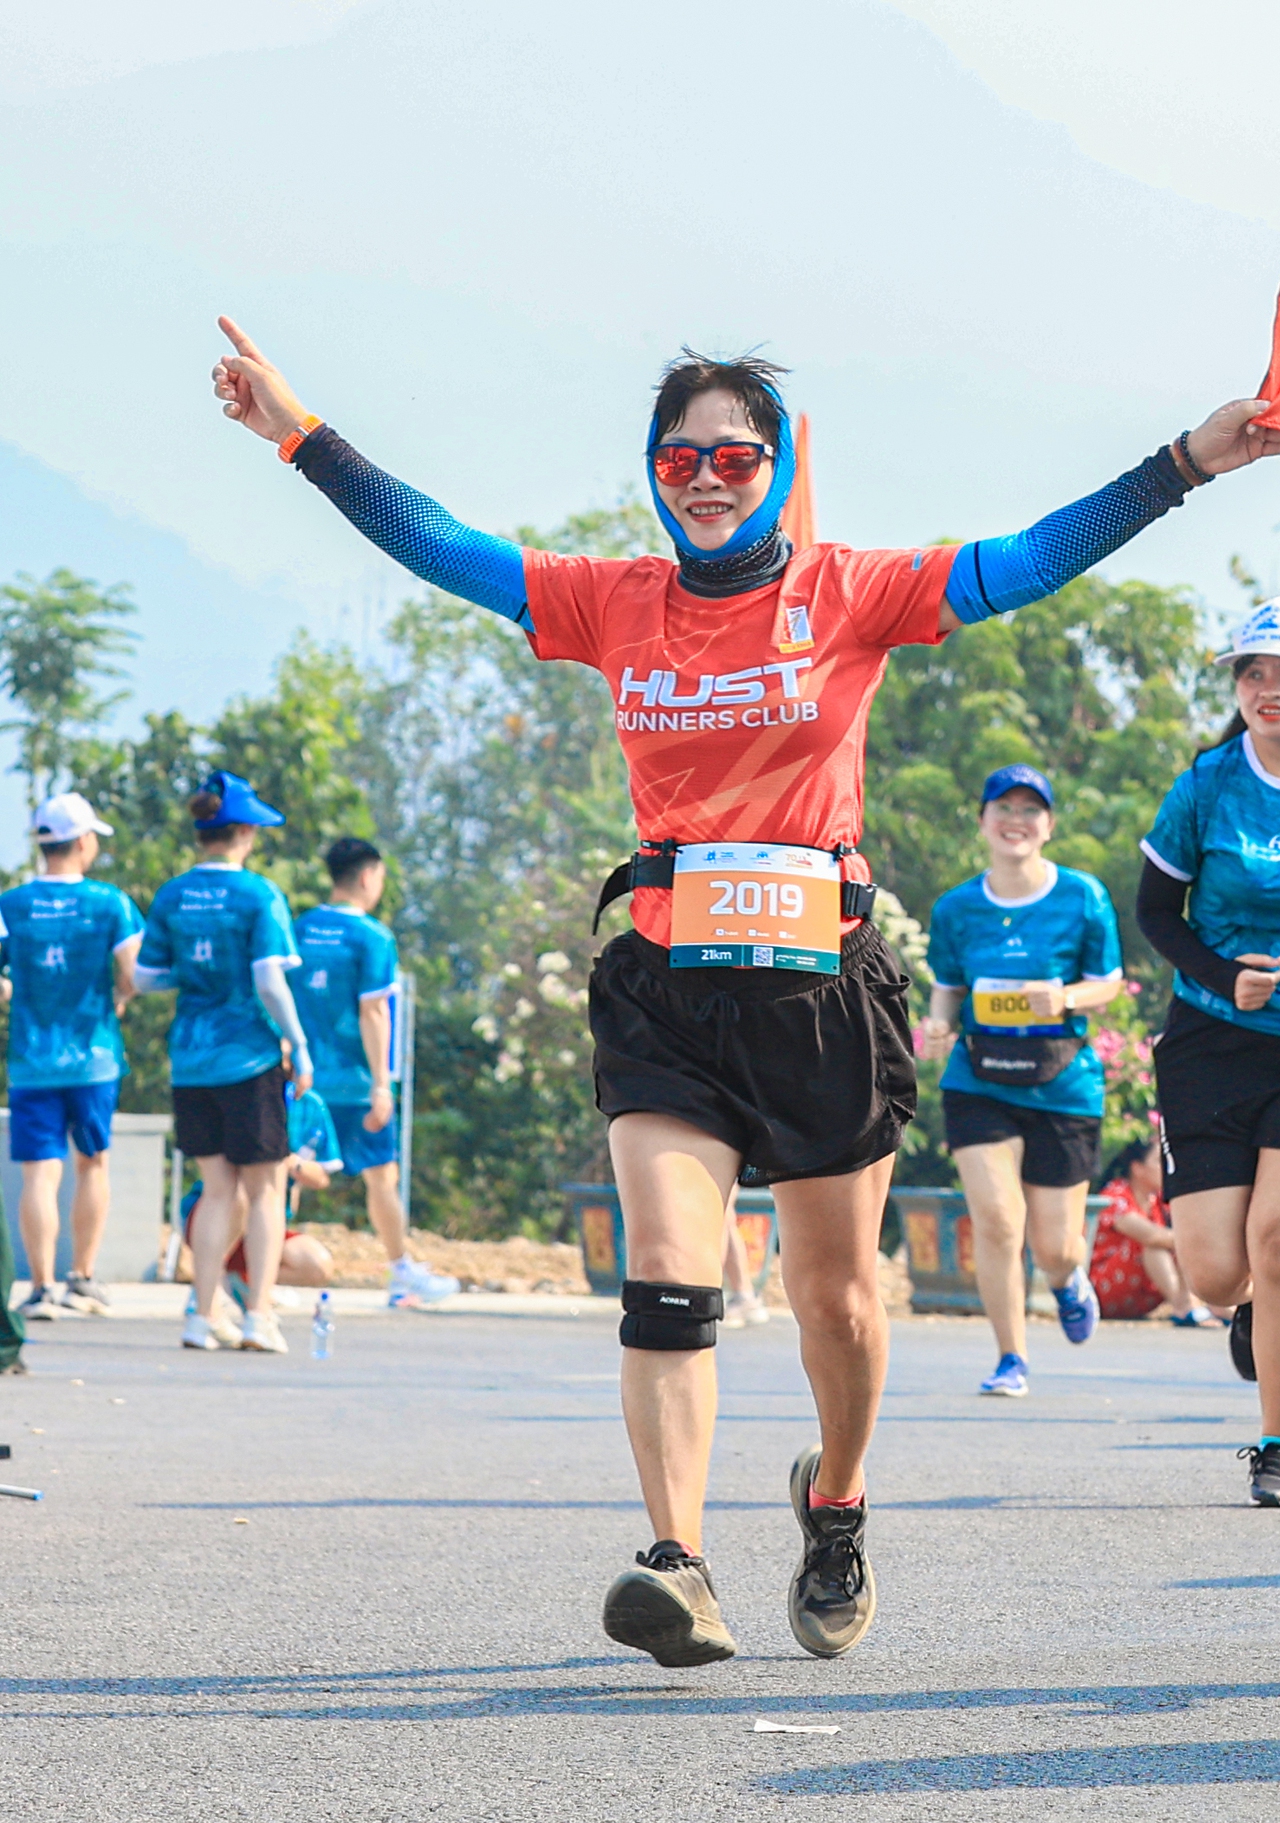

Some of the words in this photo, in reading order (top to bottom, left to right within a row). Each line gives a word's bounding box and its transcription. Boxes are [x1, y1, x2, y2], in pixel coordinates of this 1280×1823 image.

[618, 657, 813, 708] HUST
[617, 709, 736, 732] RUNNERS
[741, 701, 819, 728] CLUB
[709, 880, 804, 919] 2019
[701, 949, 733, 961] 21km
